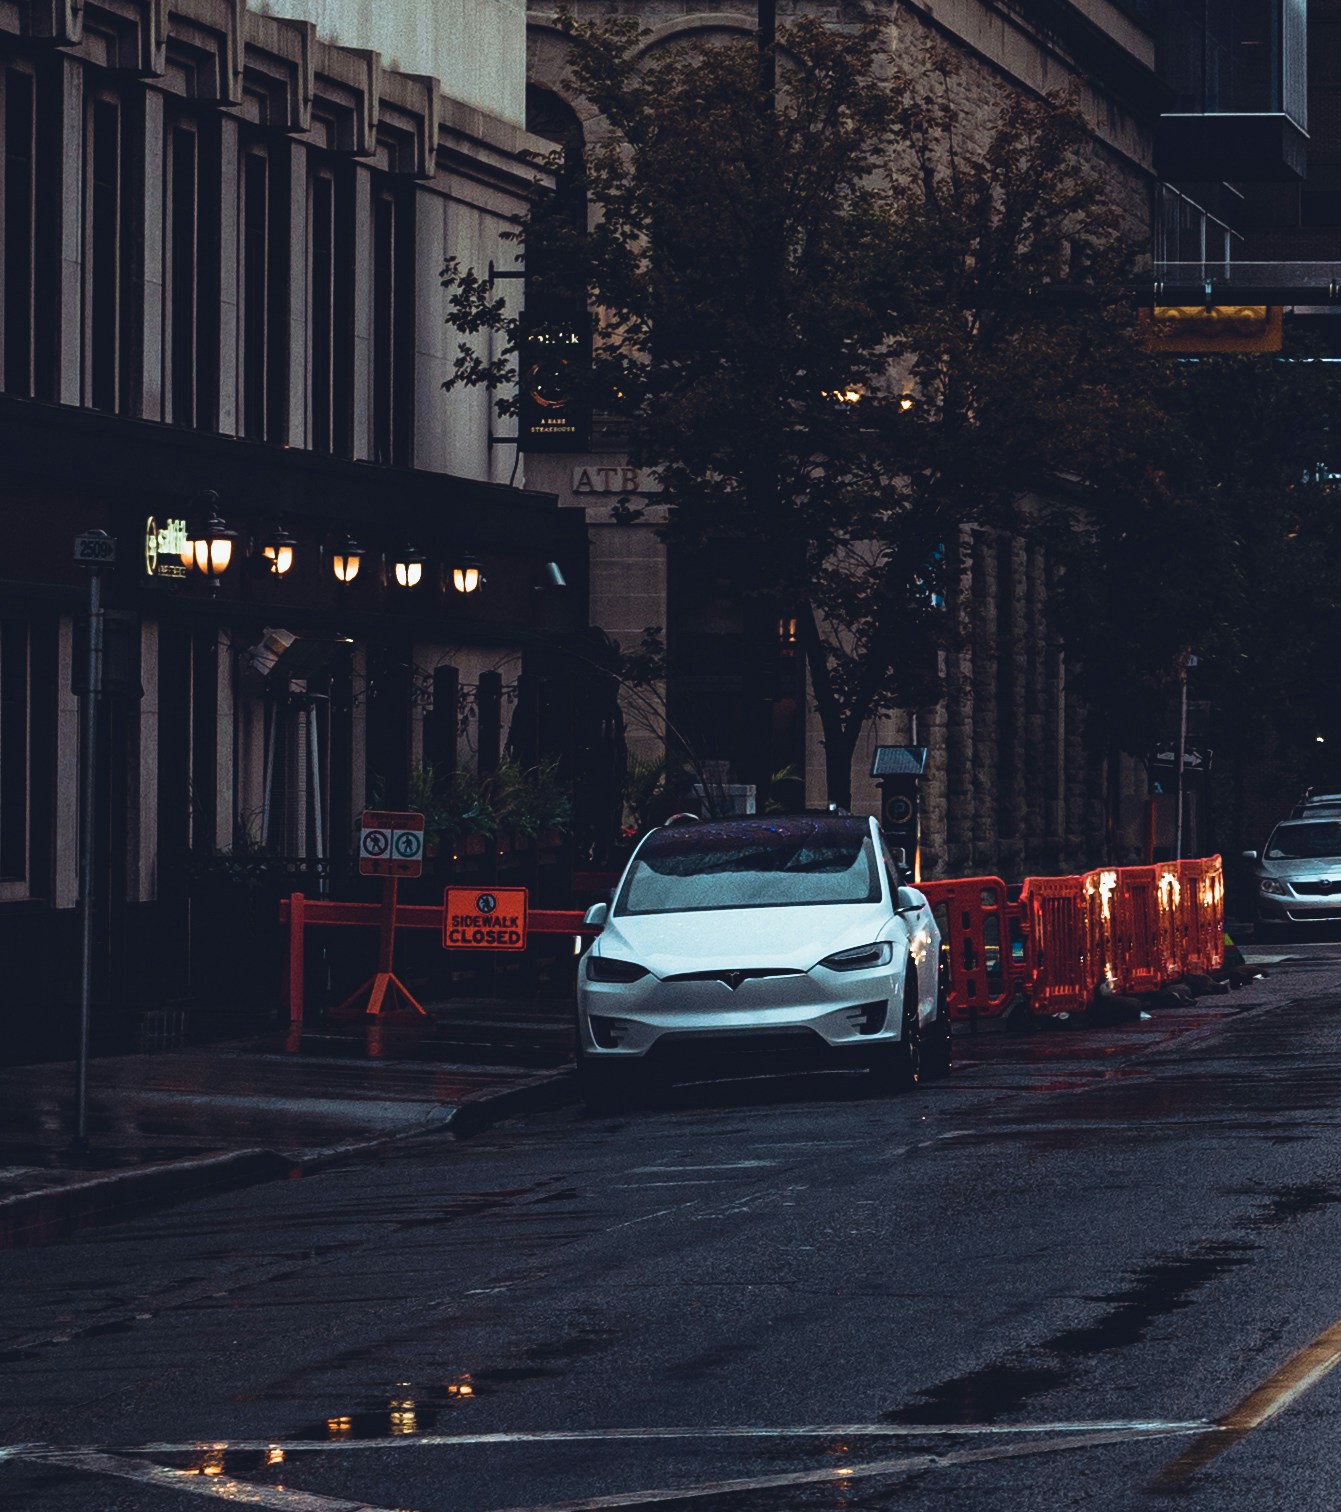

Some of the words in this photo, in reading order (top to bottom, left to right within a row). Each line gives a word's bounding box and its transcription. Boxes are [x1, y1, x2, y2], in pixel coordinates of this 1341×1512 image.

[576, 467, 640, 492] ATB
[80, 539, 108, 559] 2509
[451, 915, 519, 928] SIDEWALK
[449, 929, 521, 945] CLOSED
